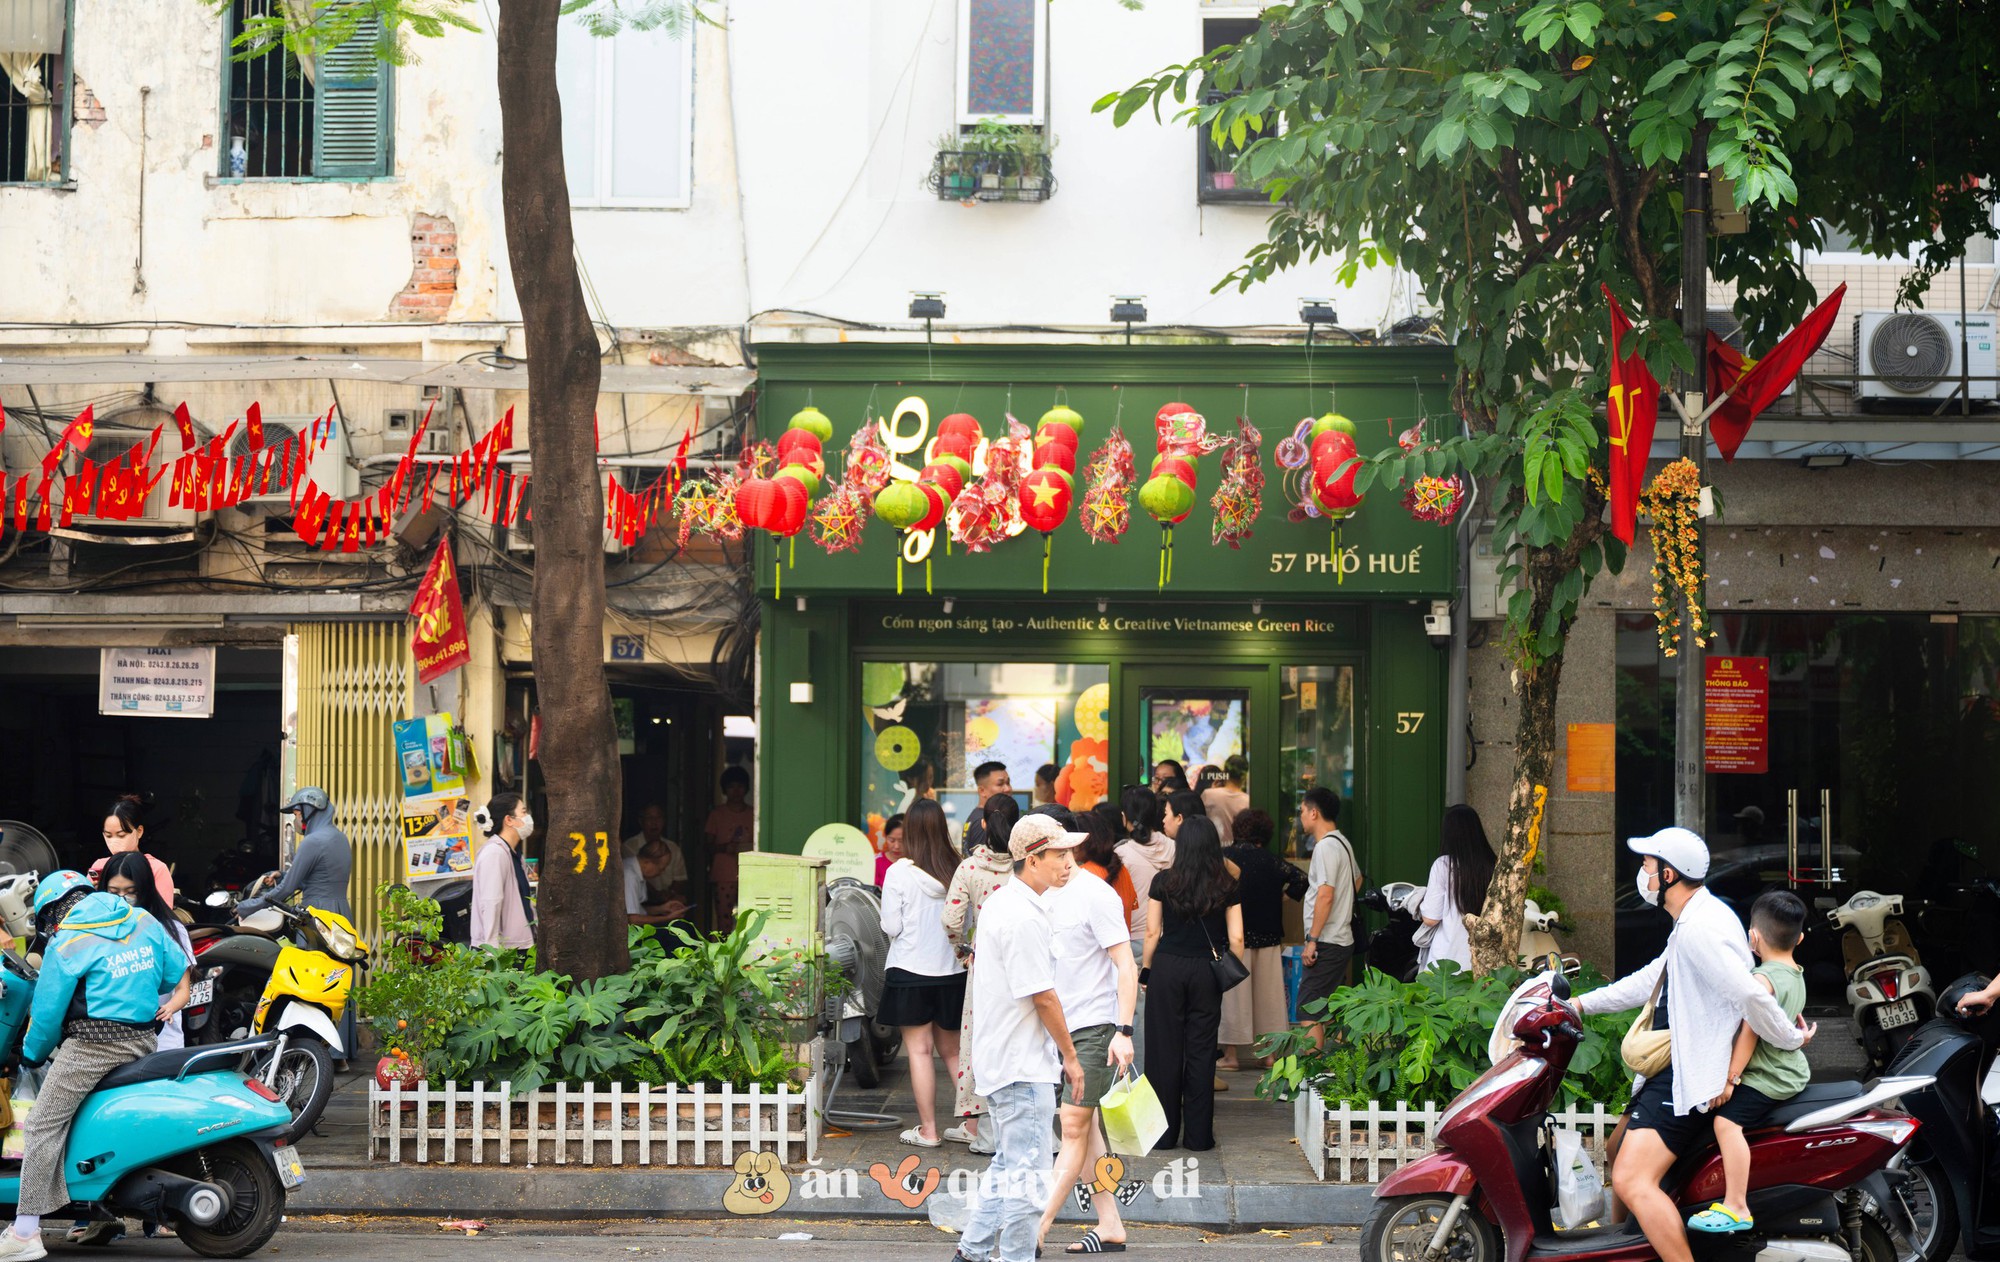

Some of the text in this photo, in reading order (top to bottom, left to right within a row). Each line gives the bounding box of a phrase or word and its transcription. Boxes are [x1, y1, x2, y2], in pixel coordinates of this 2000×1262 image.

[1270, 545, 1423, 574] 57 PHỐ HUẾ
[882, 614, 914, 629] Cốm
[919, 619, 952, 632] ngon
[956, 616, 987, 633] sáng
[992, 617, 1013, 633] tạo
[1026, 617, 1094, 630] Authentic
[1098, 617, 1110, 630] &
[1114, 617, 1171, 631] Creative
[1174, 618, 1253, 632] Vietnamese
[1257, 618, 1301, 632] Green
[1305, 619, 1335, 632] Rice
[617, 639, 638, 657] 57
[117, 660, 128, 668] HÀ
[135, 677, 151, 685] NGA:
[153, 678, 203, 687] 0243.8.215.215
[1705, 679, 1749, 688] THÔNG BÁO
[154, 695, 205, 703] 0243.8.57.57.57
[1396, 712, 1425, 734] 57
[1207, 772, 1229, 780] PUSH
[106, 945, 154, 968] XANH SM
[111, 958, 155, 979] xin chào!
[1882, 1000, 1909, 1016] 17-B1
[1881, 1010, 1916, 1028] 599.35
[1805, 1136, 1858, 1149] LEAD
